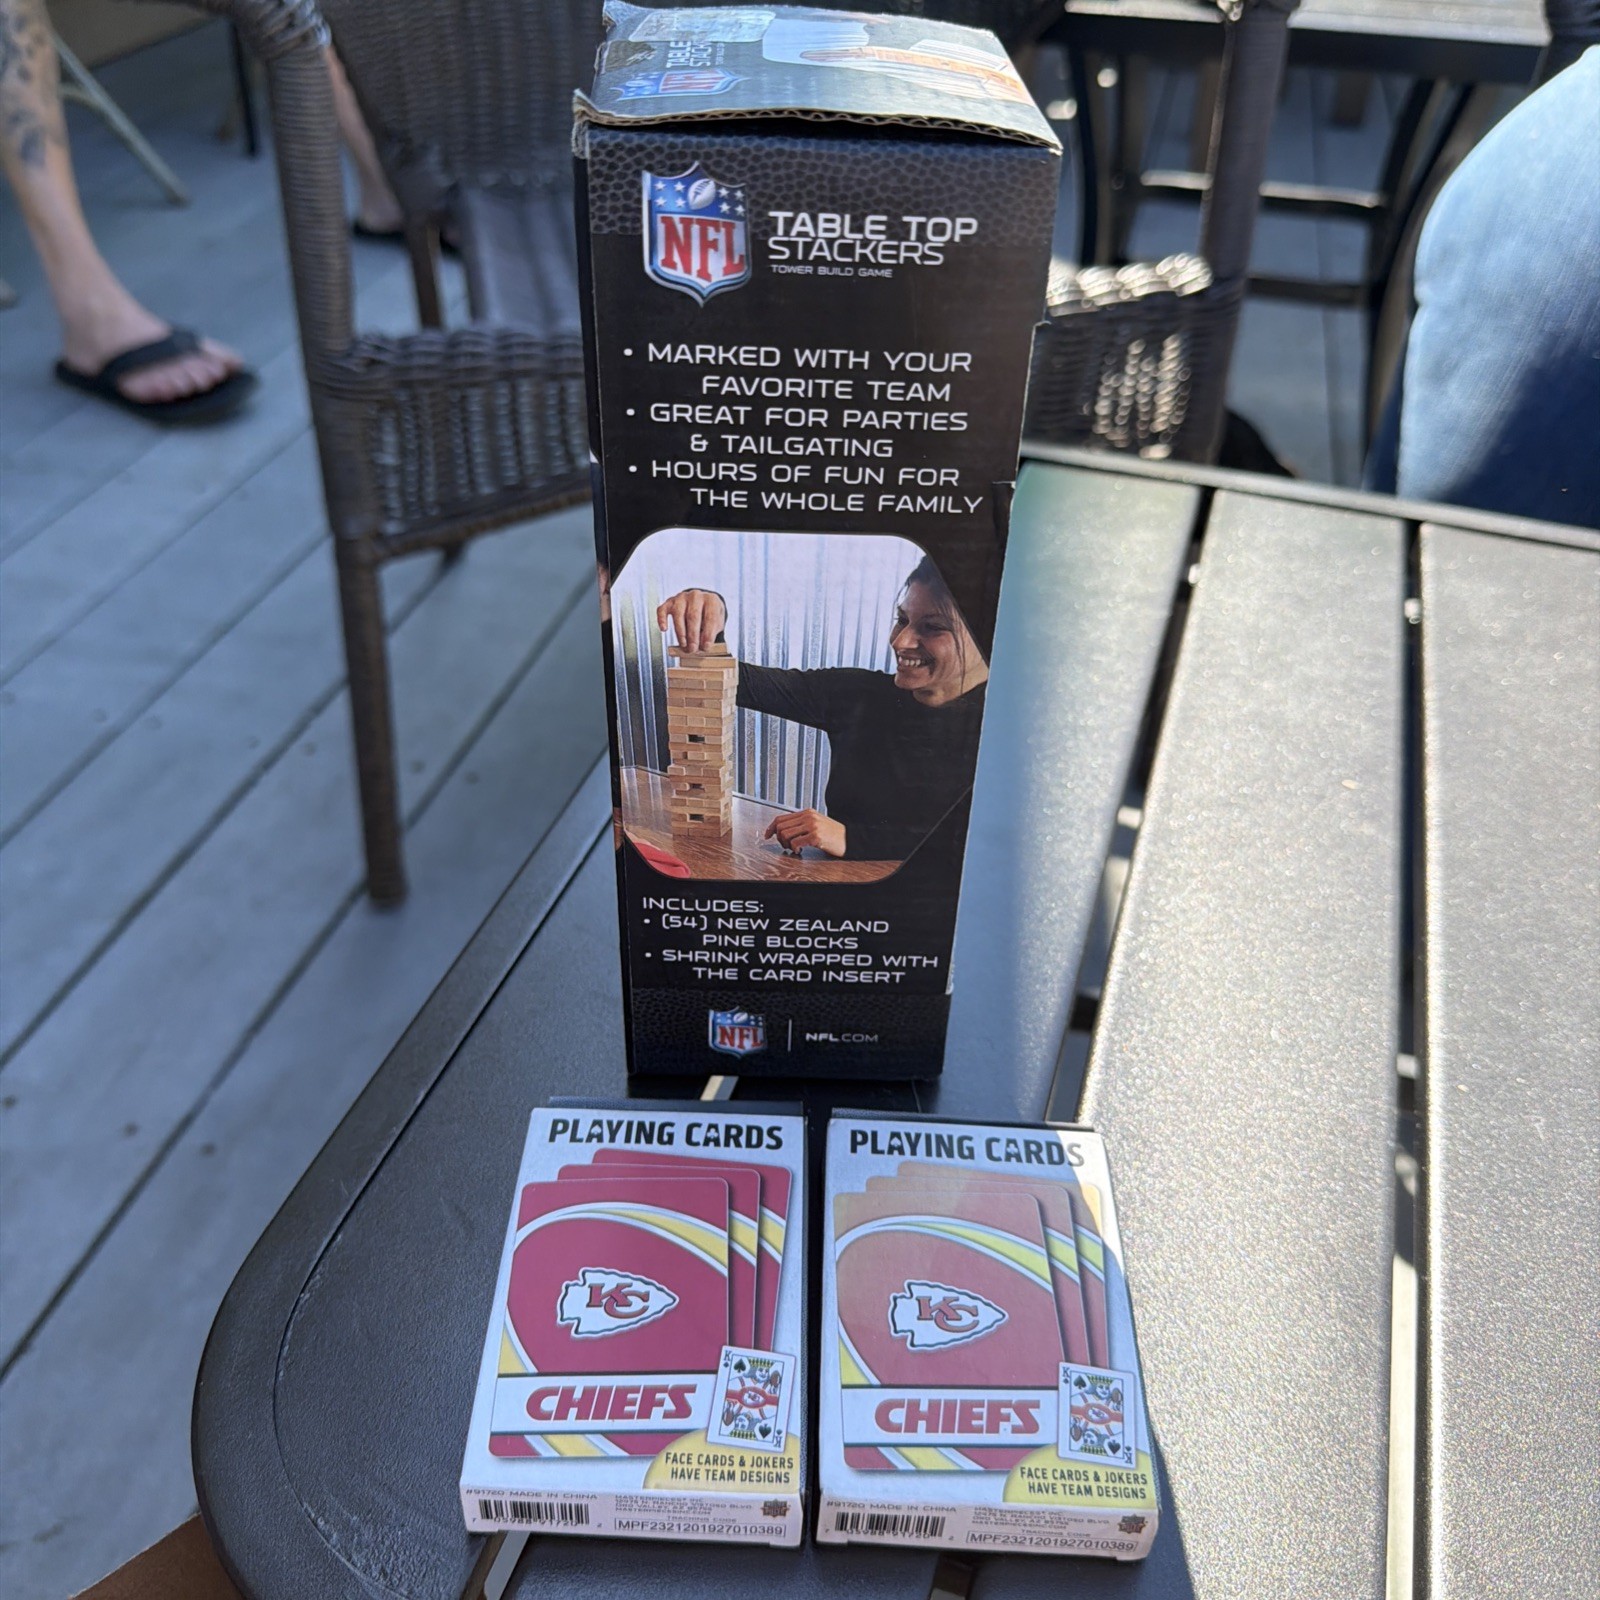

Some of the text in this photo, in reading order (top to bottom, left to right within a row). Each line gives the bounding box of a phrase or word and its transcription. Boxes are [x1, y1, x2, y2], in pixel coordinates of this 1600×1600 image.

[768, 211, 978, 242] TABLE TOP
[661, 216, 746, 283] NFL
[768, 237, 945, 265] STACKERS
[771, 264, 893, 278] TOWER BUILD GAME
[648, 343, 972, 373] MARKED WITH YOUR
[702, 375, 951, 402] FAVORITE TEAM
[650, 403, 968, 431] GREAT FOR PARTIES
[690, 434, 893, 458] & TAILGATING
[652, 460, 959, 487] HOURS OF FUN FOR
[690, 488, 983, 514] THE WHOLE FAMILY
[643, 897, 764, 913] INCLUDES:
[662, 913, 889, 933] (54) NEW ZEALAND
[703, 934, 858, 949] PINE BLOCKS
[663, 949, 938, 968] SHRINK WRAPPED WITH
[693, 967, 905, 983] THE CARD INSERT
[718, 1026, 763, 1049] NFL
[548, 1118, 783, 1150] PLAYING CARDS
[850, 1129, 1085, 1167] PLAYING CARDS
[586, 1282, 650, 1319] KC
[916, 1296, 979, 1333] KC
[724, 1350, 732, 1361] K
[1062, 1366, 1070, 1378] K
[525, 1383, 697, 1422] CHIEFS
[874, 1398, 1041, 1435] CHIEFS
[665, 1452, 794, 1469] FACE CARDS & JOKERS
[671, 1466, 790, 1484] HAVE TEAM DESIGNS
[1020, 1466, 1147, 1485] FACE CARDS & JOKERS
[1028, 1481, 1146, 1499] HAVE TEAM DESIGNS
[618, 1520, 783, 1536] MPF2321201927010389
[970, 1533, 1135, 1550] MPF2321201927010389
